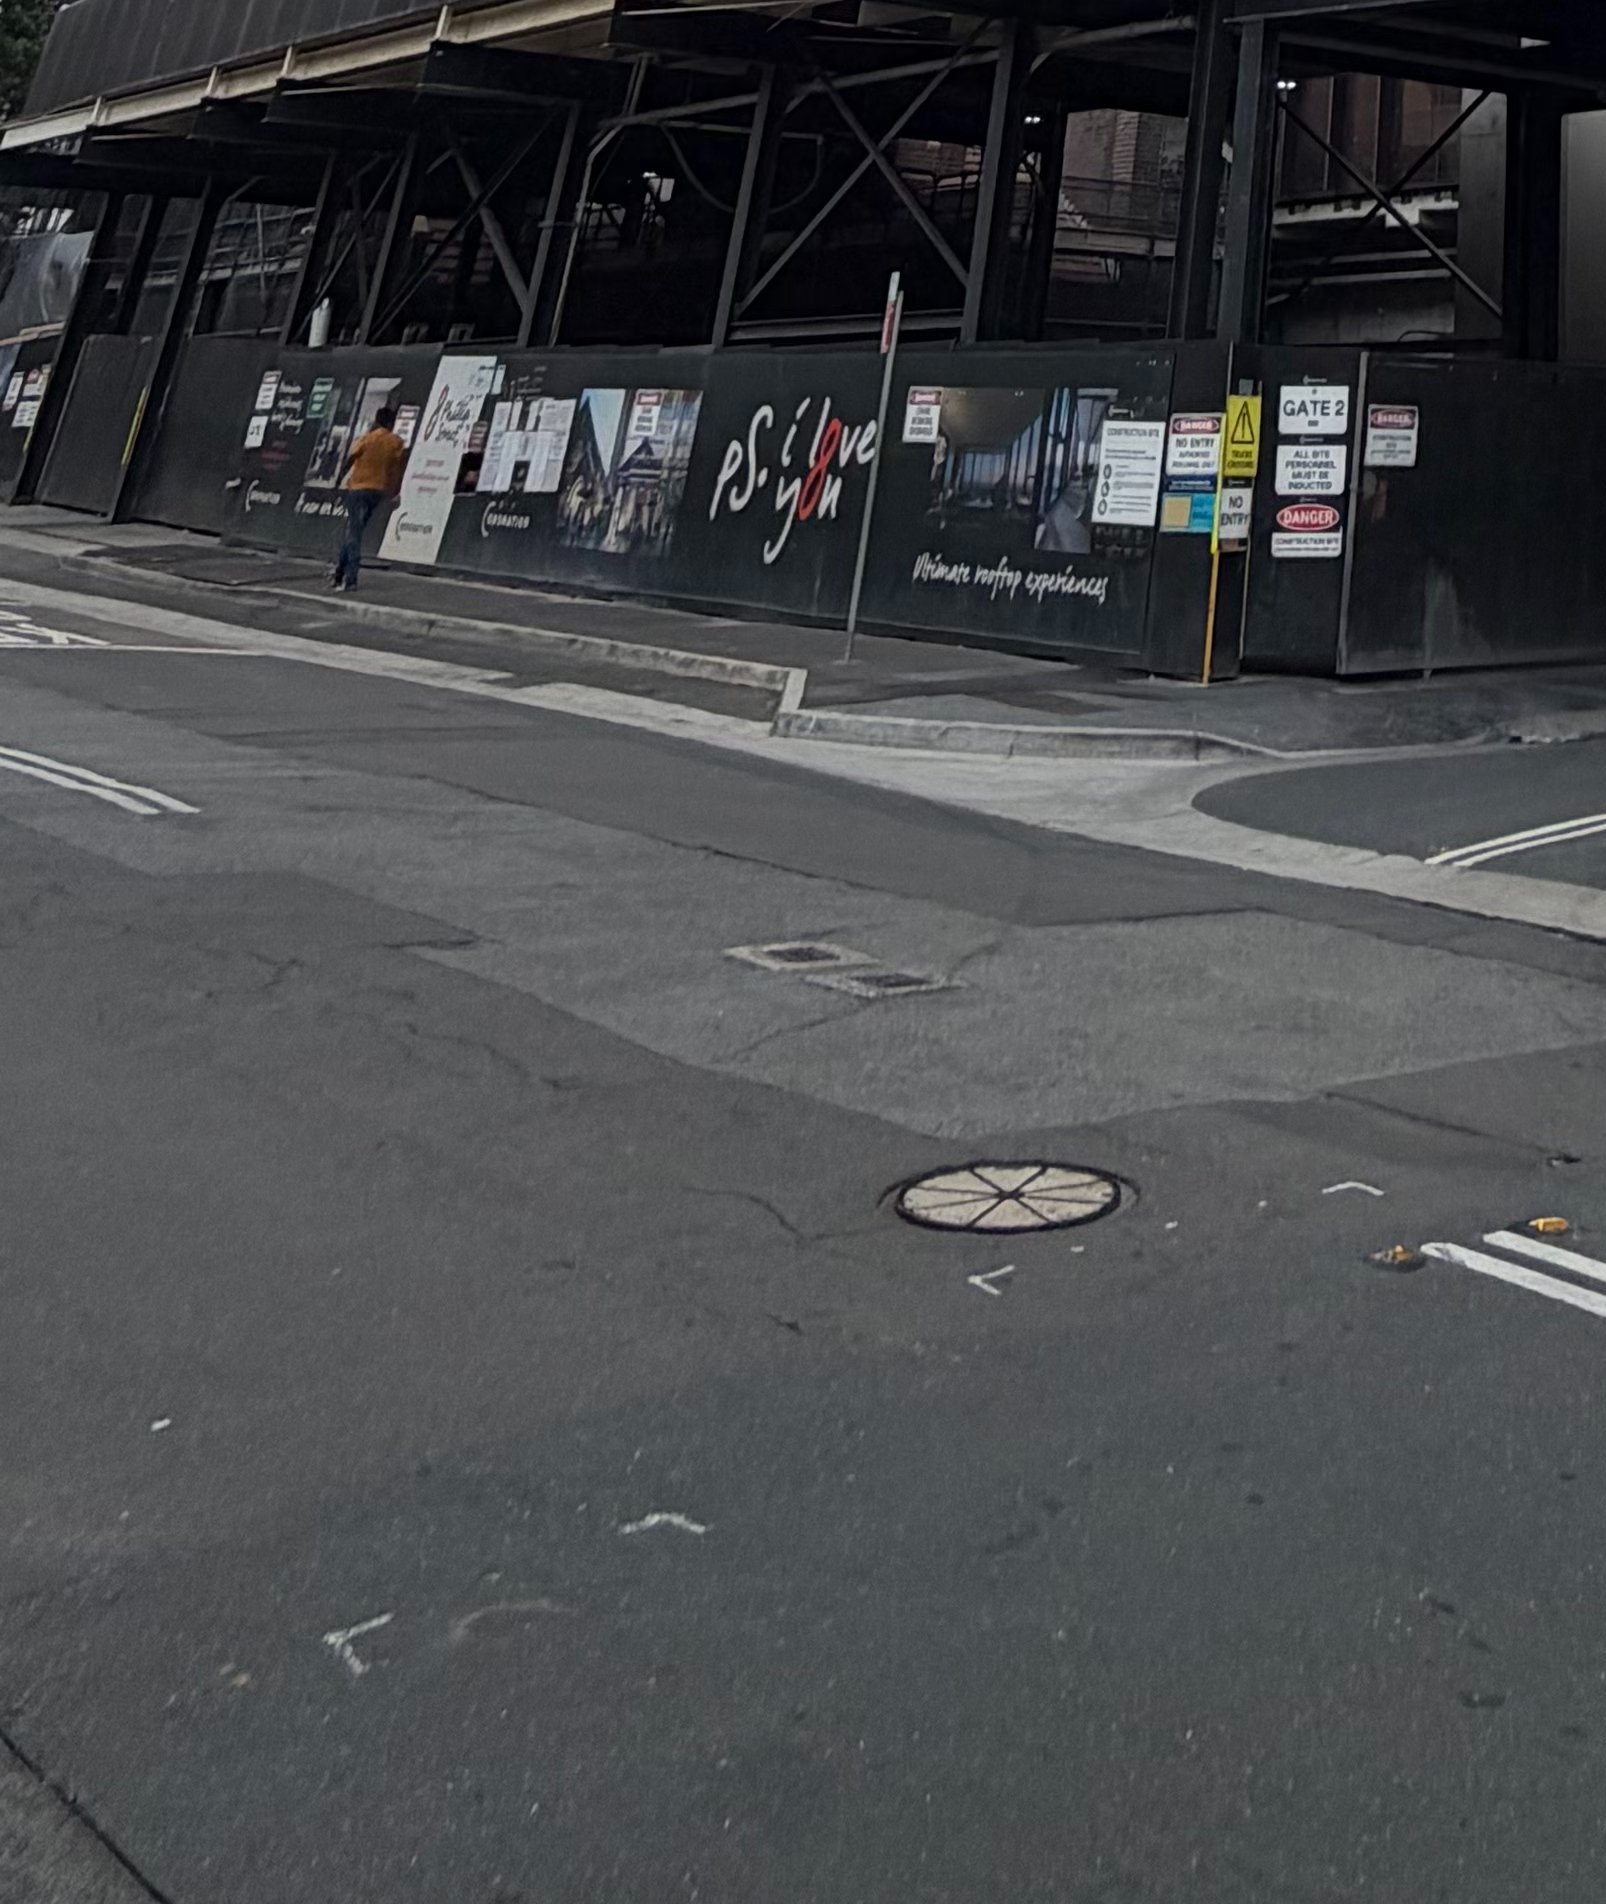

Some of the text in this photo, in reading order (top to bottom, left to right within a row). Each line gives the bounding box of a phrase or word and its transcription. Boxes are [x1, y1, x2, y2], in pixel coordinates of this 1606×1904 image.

[1283, 399, 1345, 417] GATE 2
[1175, 437, 1215, 448] NO ENTRY
[1293, 450, 1330, 459] ALL SITE
[1284, 460, 1337, 470] PERSONNEL
[1291, 471, 1330, 480] MUST BE
[1288, 481, 1333, 490] INDUCTED
[1229, 495, 1244, 509] NO
[1220, 513, 1249, 526] ENTRY
[1284, 509, 1334, 525] DANGER
[912, 551, 1110, 605] Ultimate rooftop experiences
